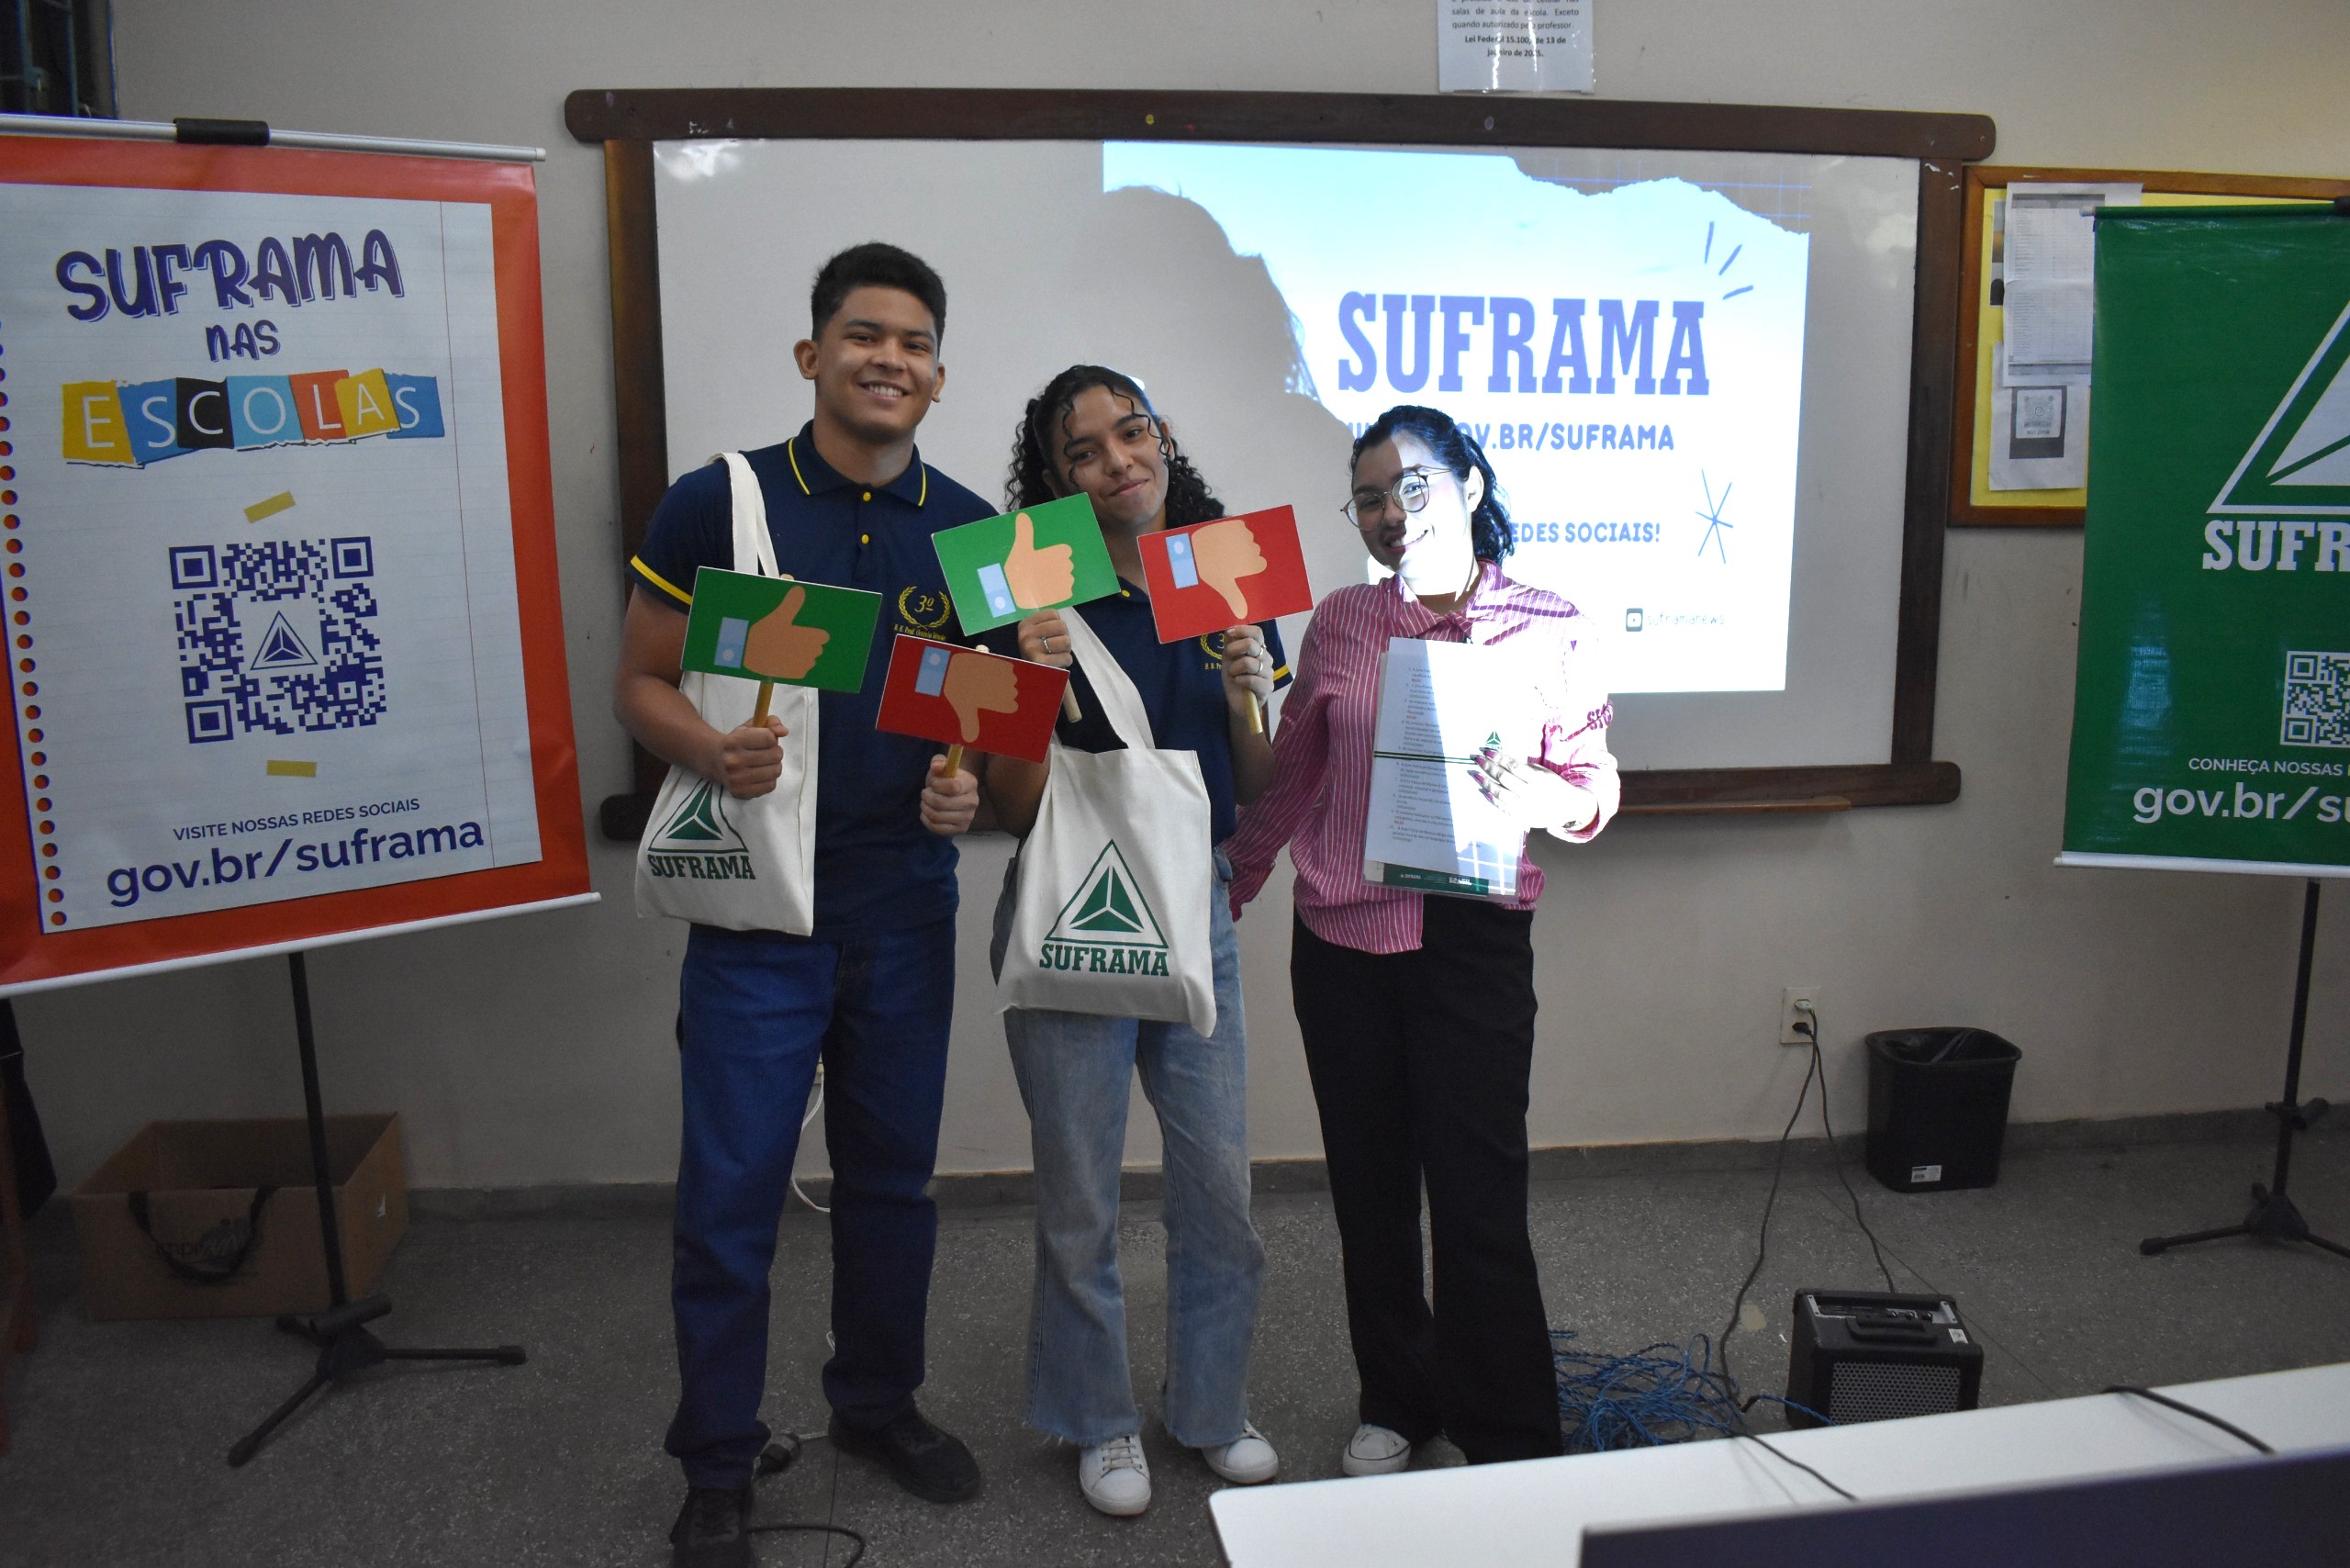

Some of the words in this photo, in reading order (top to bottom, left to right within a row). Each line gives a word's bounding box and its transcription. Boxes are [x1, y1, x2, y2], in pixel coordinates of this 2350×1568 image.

[1452, 20, 1480, 29] quando
[1482, 20, 1519, 28] autorizado
[1538, 21, 1573, 29] professor.
[1465, 35, 1475, 43] Lei
[1505, 36, 1531, 45] 15.100,
[1487, 48, 1512, 57] jaeiro
[1524, 49, 1544, 57] 205.
[56, 229, 405, 322] SUFRAMA
[206, 319, 281, 363] NAS
[1338, 291, 1710, 396] SUFRAMA
[83, 383, 421, 449] ESCOLAS
[1510, 521, 1560, 543] EDES
[1564, 521, 1660, 543] SOCIAIS!
[1647, 611, 1725, 626] suframanews
[2188, 757, 2270, 775] CONHEÇA
[2274, 760, 2344, 776] NOSSAS
[2133, 781, 2350, 823] gov.br/s
[173, 823, 228, 841] VISITE
[232, 814, 298, 834] NOSSAS
[302, 807, 355, 825] REDES
[359, 798, 420, 818] SOCIAIS
[107, 821, 484, 908] gov.br/suframa
[647, 854, 756, 879] SUFRAMA
[1039, 943, 1169, 977] SUFRAMA
